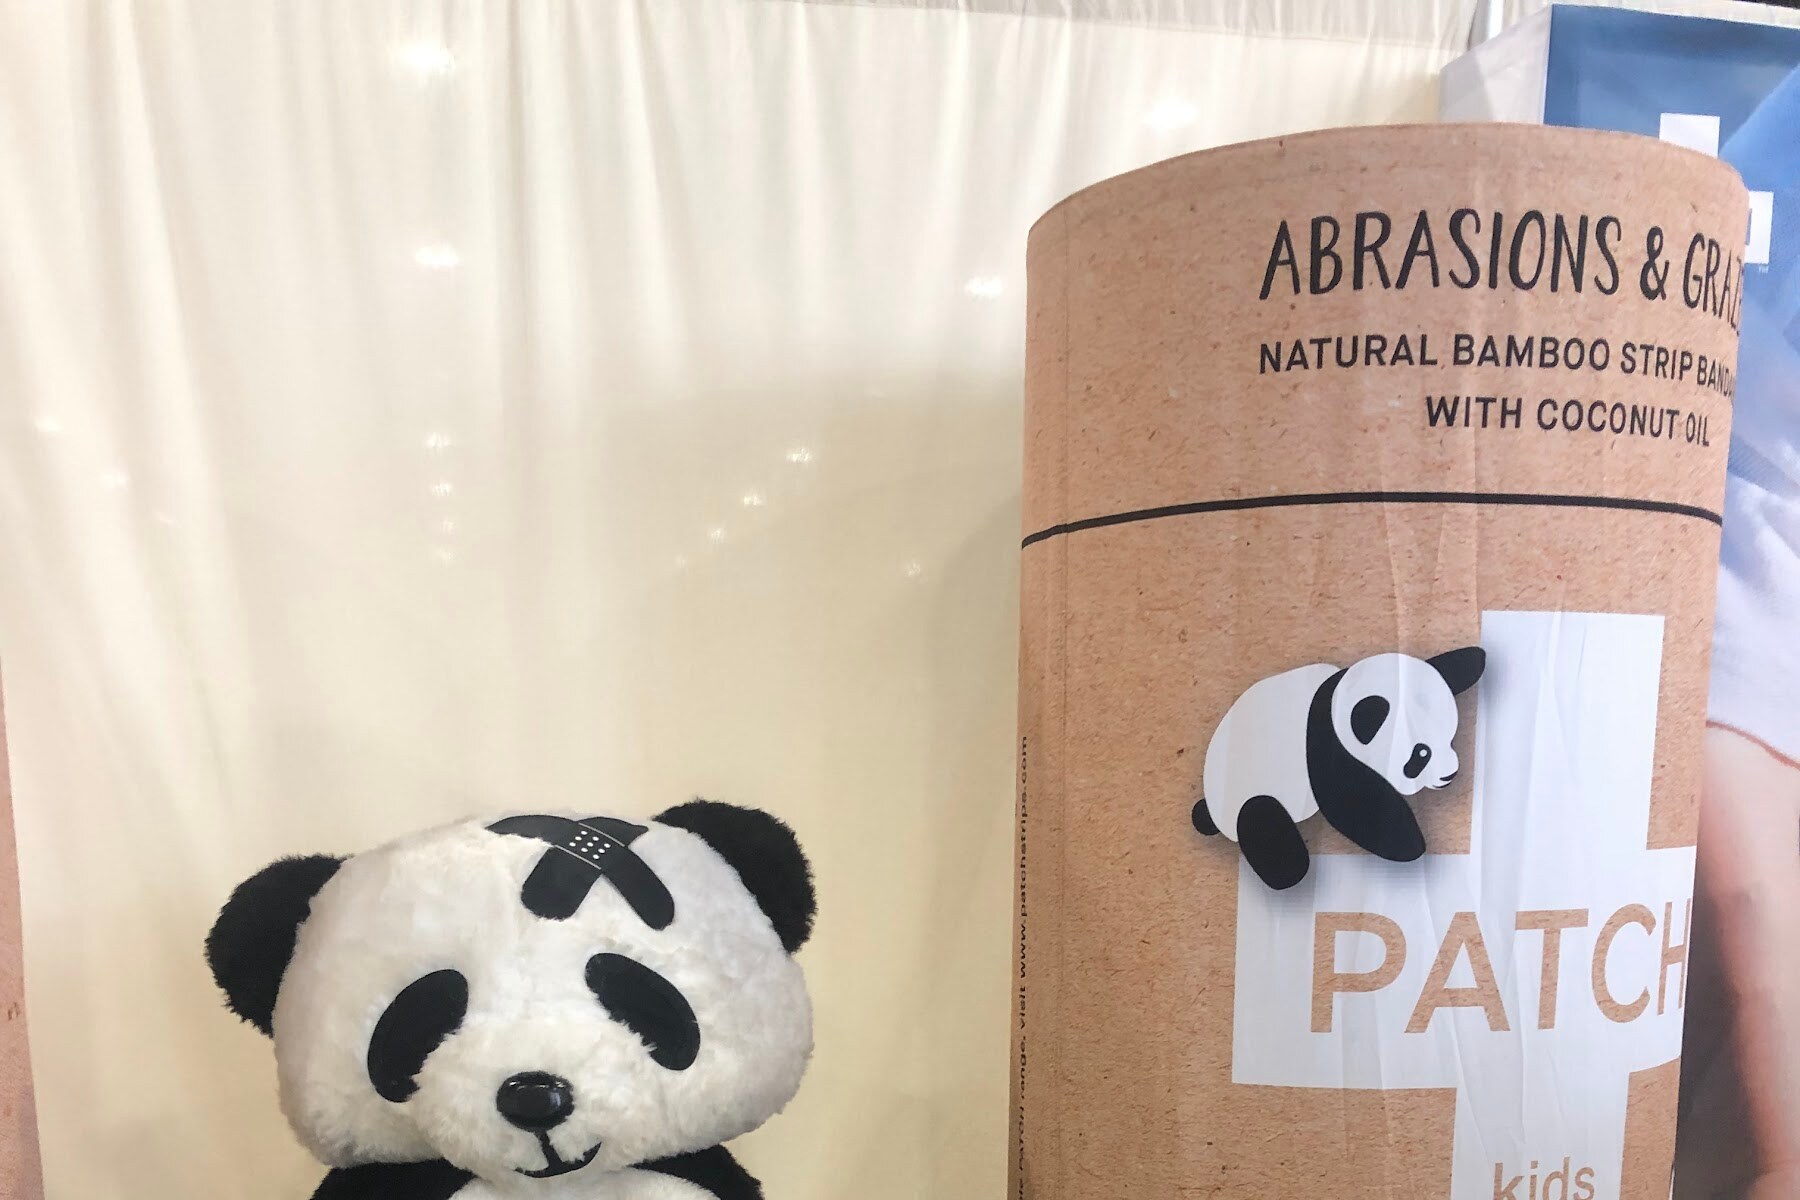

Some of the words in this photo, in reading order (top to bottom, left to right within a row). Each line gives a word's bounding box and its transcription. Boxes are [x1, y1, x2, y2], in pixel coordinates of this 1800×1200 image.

[1259, 208, 1622, 300] ABRASIONS
[1639, 226, 1670, 301] &
[1682, 232, 1744, 337] GRAZ
[1259, 334, 1437, 374] NATURAL
[1452, 333, 1610, 373] BAMBOO
[1620, 343, 1692, 382] STRIP
[1426, 396, 1522, 428] WITH
[1536, 398, 1680, 440] COCONUT
[1686, 411, 1710, 447] OIL
[1310, 898, 1691, 1034] PATCH
